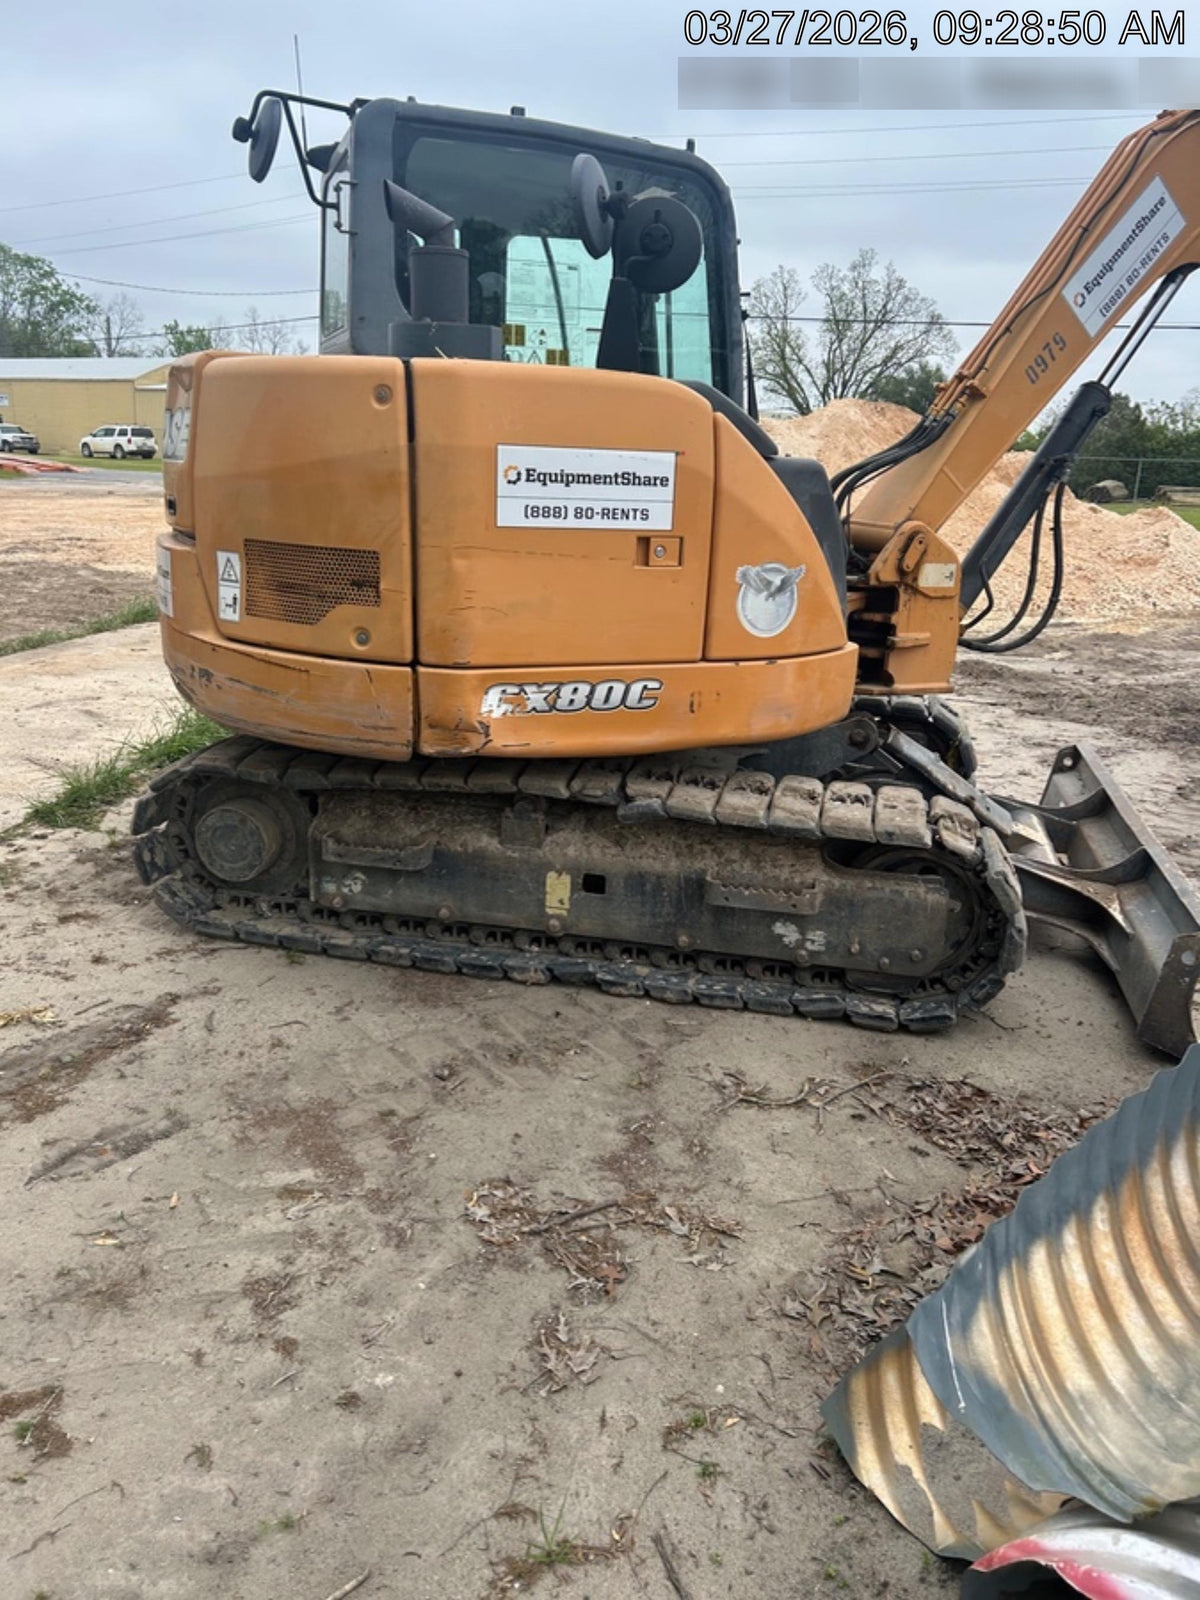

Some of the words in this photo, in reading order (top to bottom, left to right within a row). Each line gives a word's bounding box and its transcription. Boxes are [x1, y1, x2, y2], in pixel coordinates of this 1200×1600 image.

[1083, 196, 1167, 296] EquipmentShare
[1099, 284, 1128, 318] (888)
[1124, 232, 1171, 287] 80-RENTS
[1024, 331, 1068, 385] 0979
[524, 467, 670, 488] EquipmentShare
[523, 504, 568, 521] (888)
[573, 506, 650, 522] 80-RENTS
